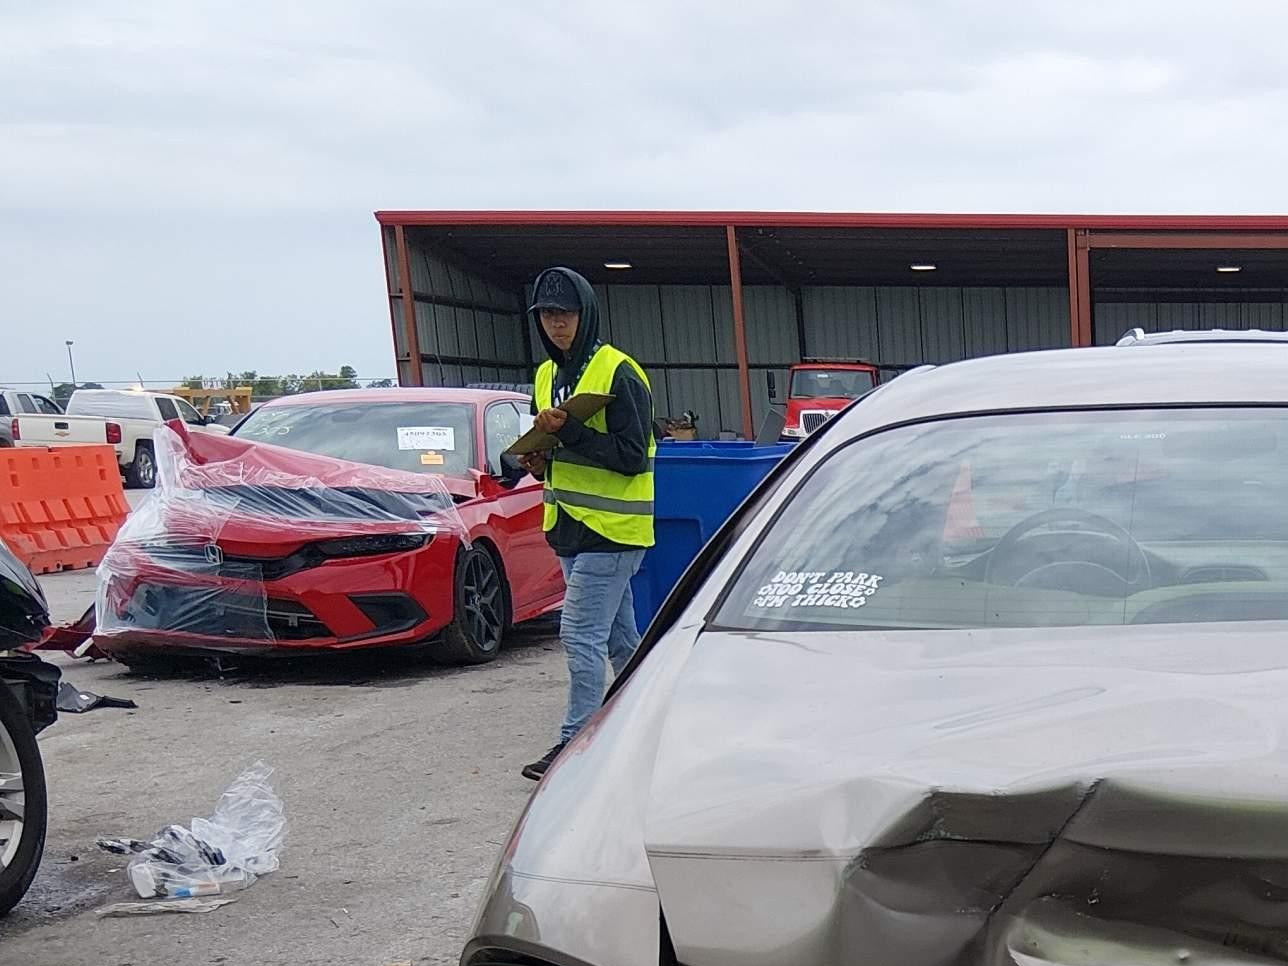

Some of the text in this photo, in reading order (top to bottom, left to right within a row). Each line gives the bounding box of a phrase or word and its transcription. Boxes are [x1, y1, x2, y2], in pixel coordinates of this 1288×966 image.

[771, 571, 883, 588] DON'T PARK
[769, 583, 867, 596] TOO CLOSE
[760, 594, 853, 608] I'M THICK
